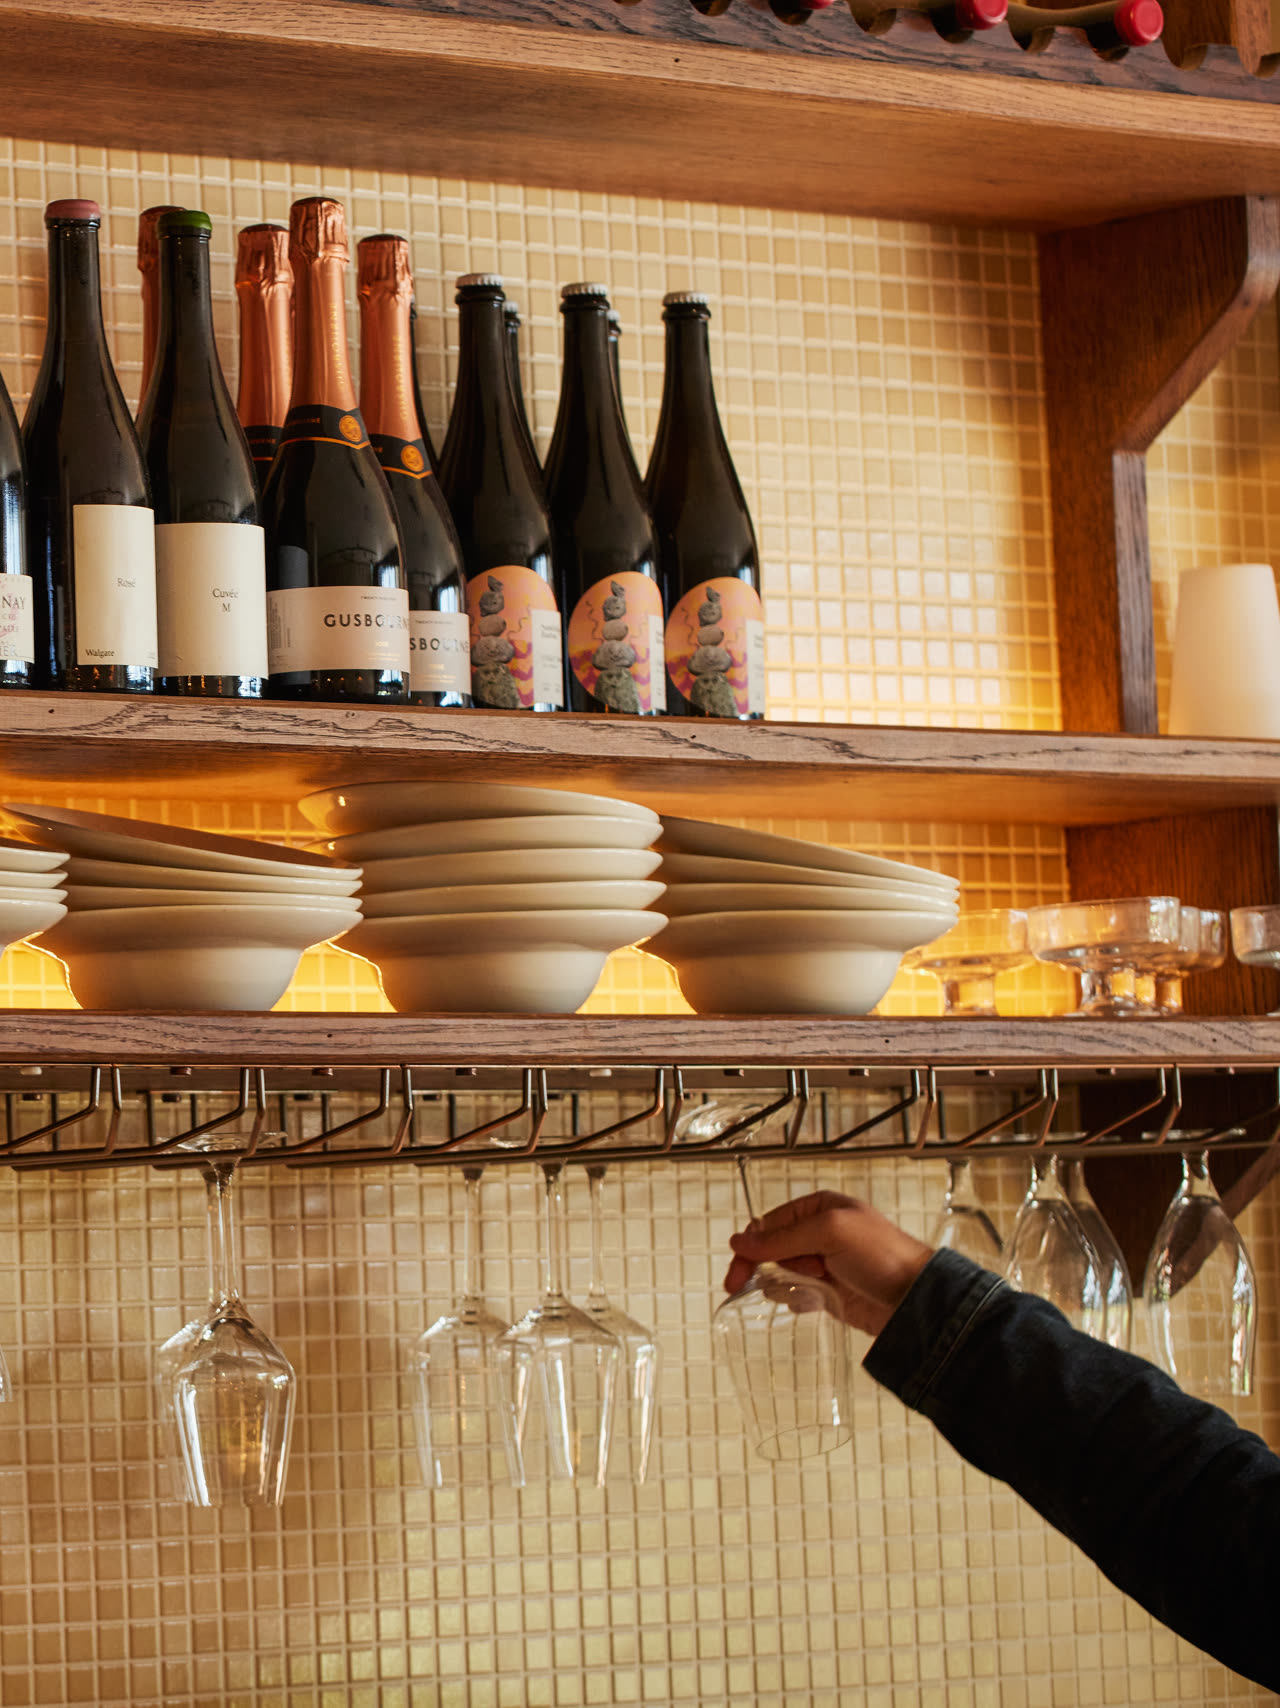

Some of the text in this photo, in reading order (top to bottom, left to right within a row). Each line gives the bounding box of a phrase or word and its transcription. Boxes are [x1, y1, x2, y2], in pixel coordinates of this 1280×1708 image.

[117, 576, 137, 588] Rosé
[212, 587, 239, 599] Cuvée
[222, 602, 231, 613] M
[85, 648, 116, 658] Walgate
